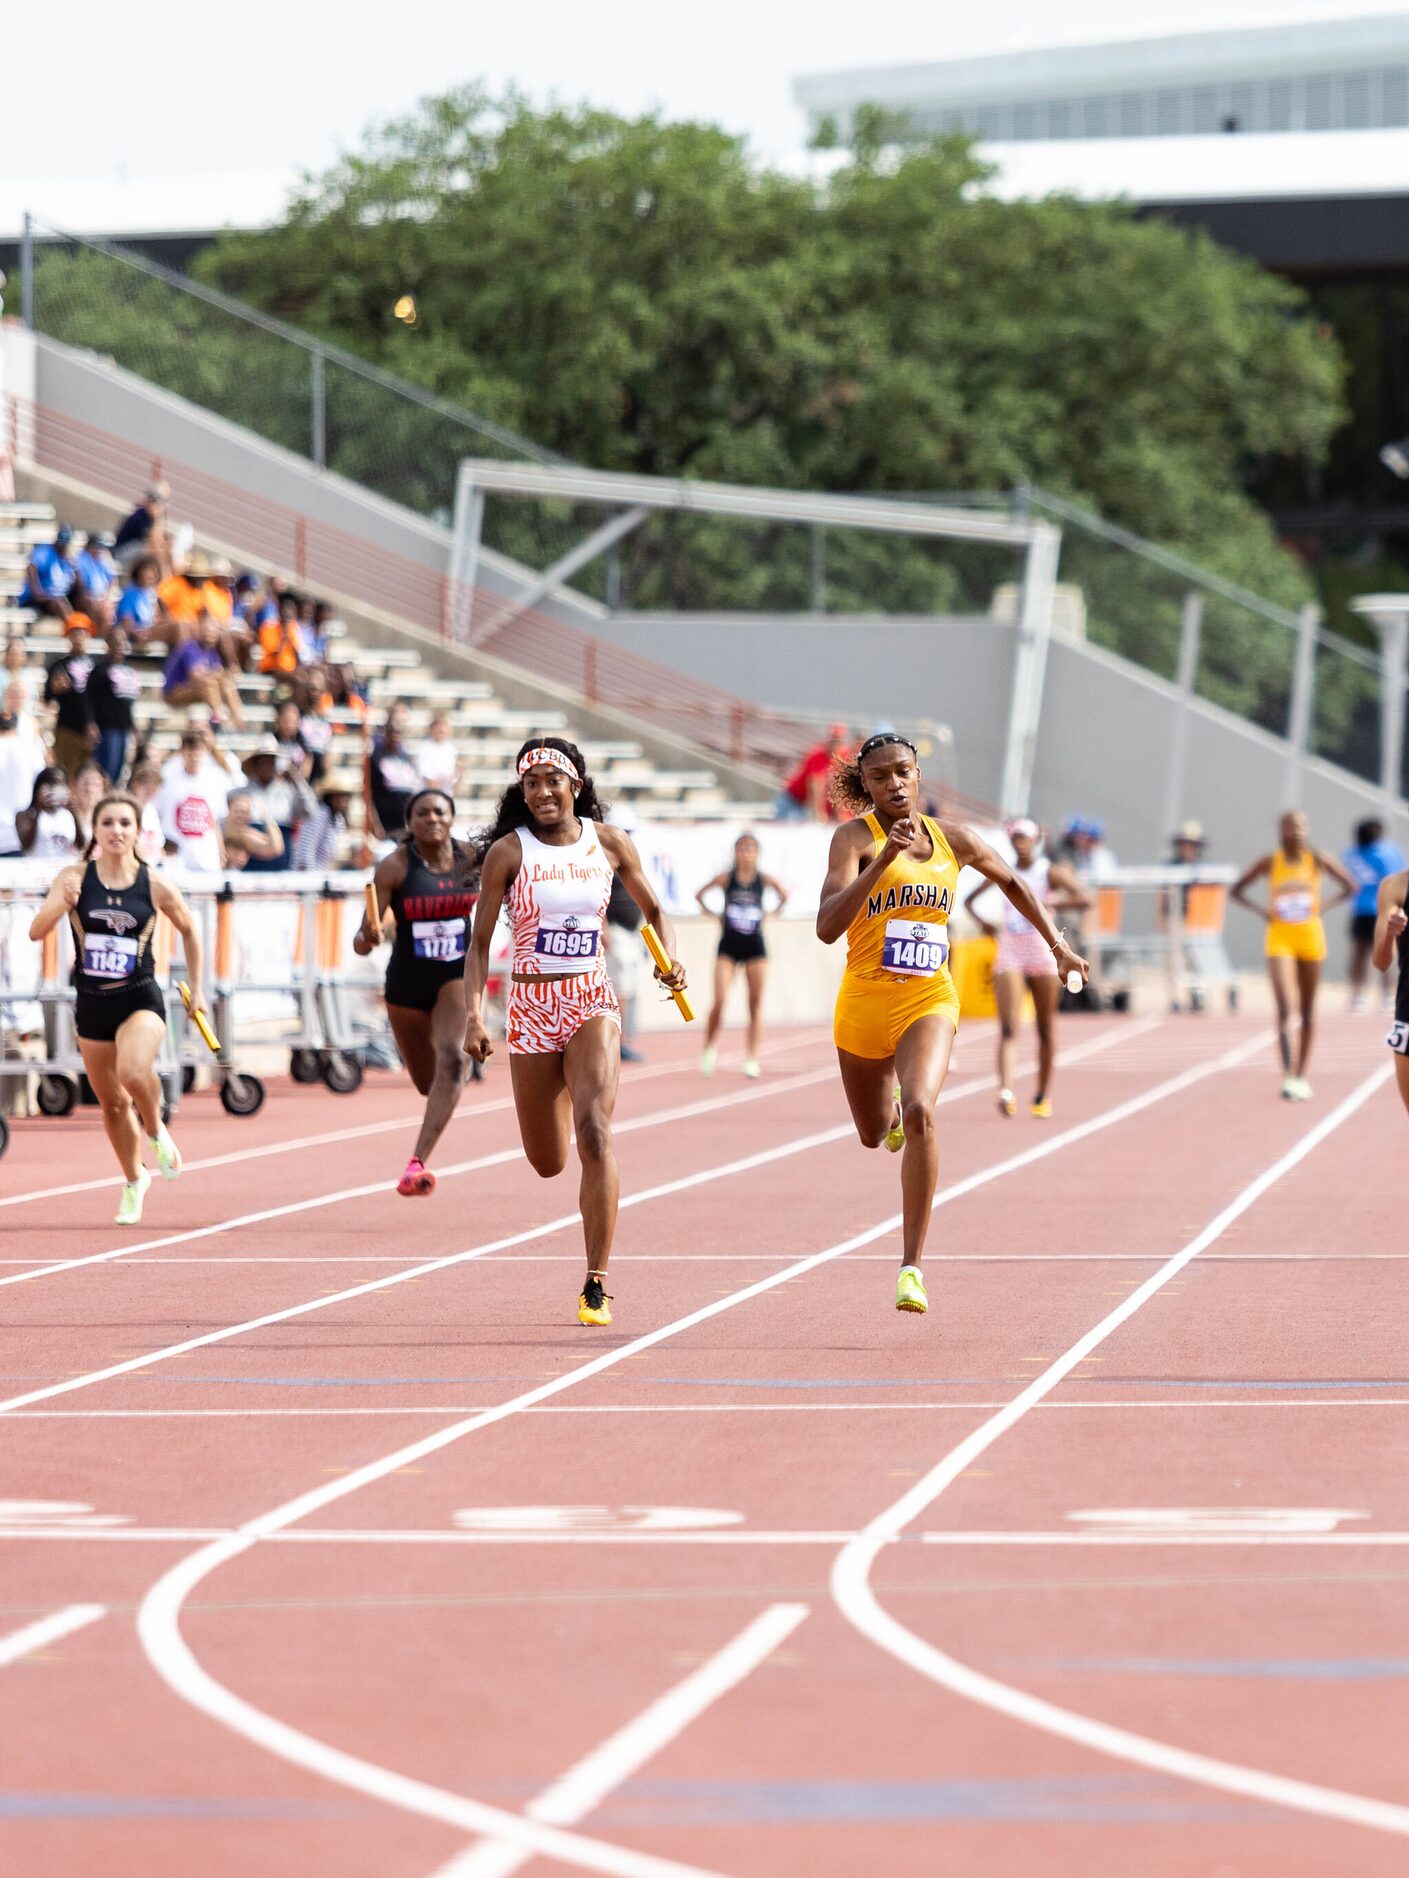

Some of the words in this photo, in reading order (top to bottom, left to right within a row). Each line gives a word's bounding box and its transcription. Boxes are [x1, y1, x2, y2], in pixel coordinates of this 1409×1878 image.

[532, 863, 564, 883] Lady
[567, 863, 603, 882] Tigers
[543, 932, 593, 955] 1695
[891, 941, 942, 969] 1409
[90, 950, 128, 972] 1142
[1387, 1024, 1405, 1048] 5
